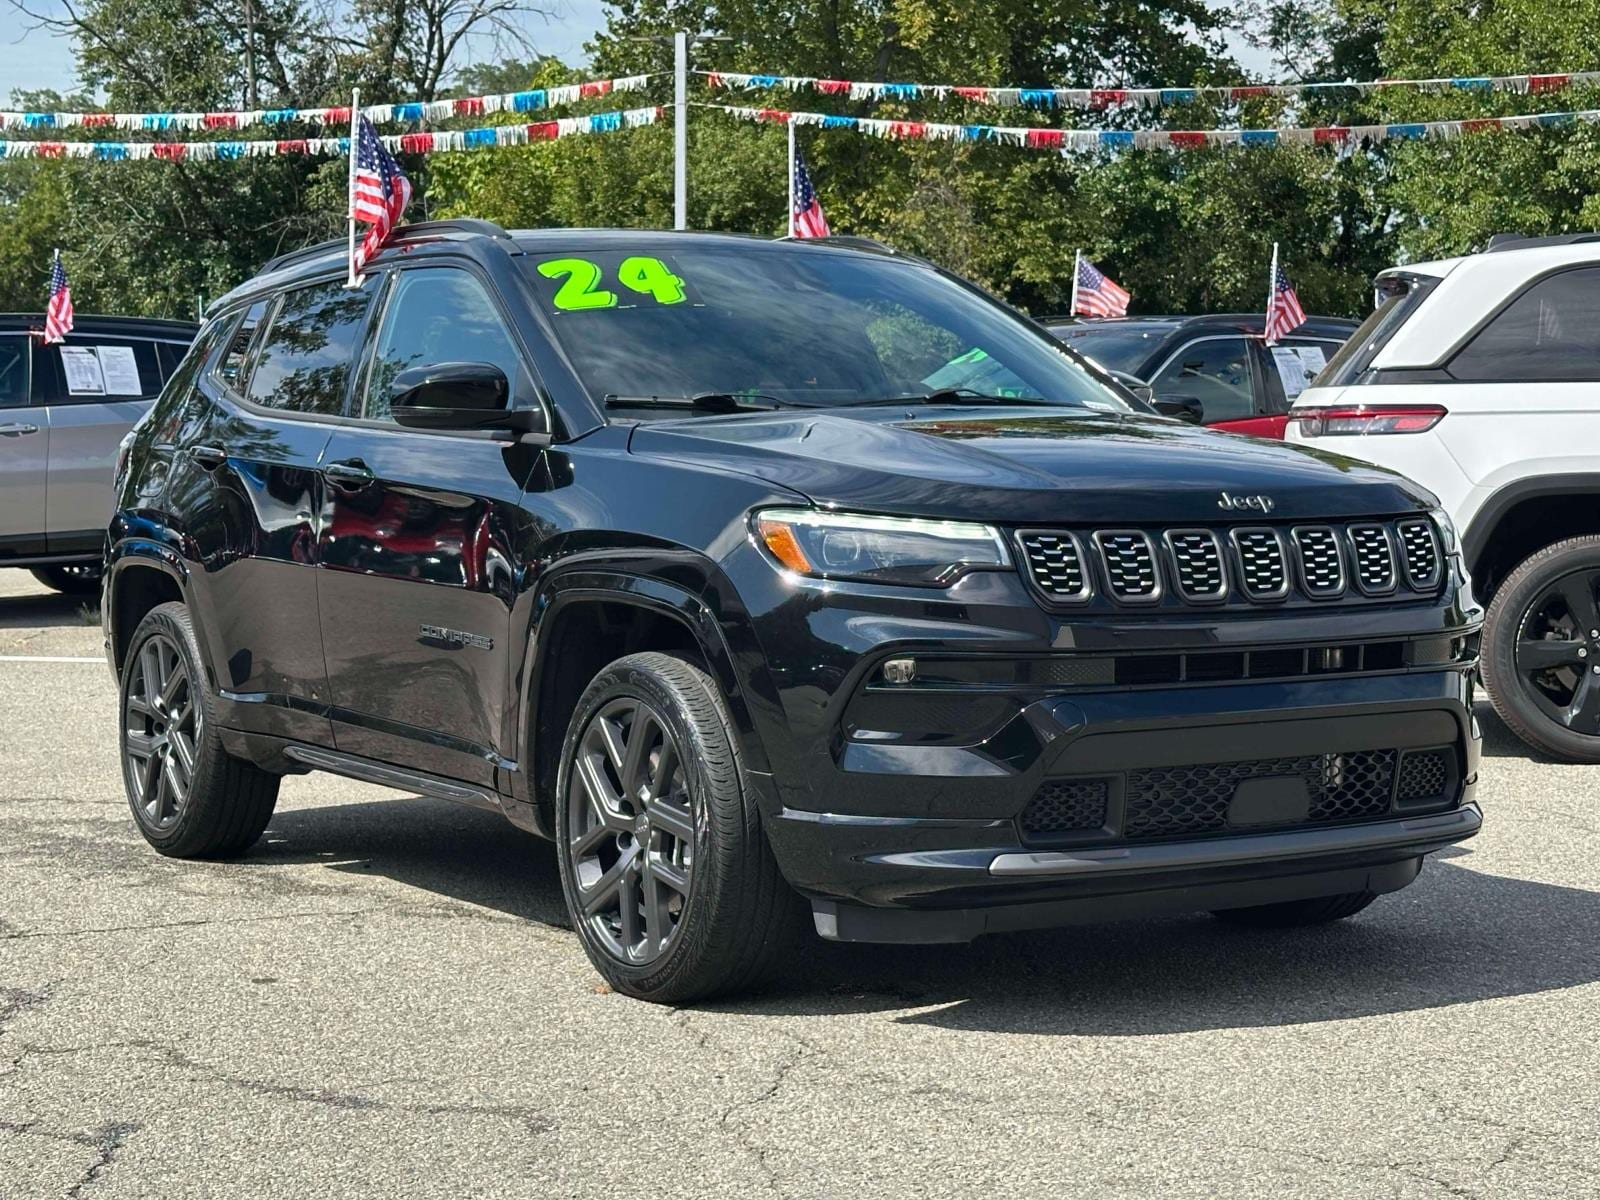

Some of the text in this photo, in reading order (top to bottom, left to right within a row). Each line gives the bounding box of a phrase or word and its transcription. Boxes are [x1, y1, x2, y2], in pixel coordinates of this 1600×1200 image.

[536, 256, 687, 311] 24
[1217, 491, 1275, 513] Jeep
[419, 624, 494, 650] COMPASS
